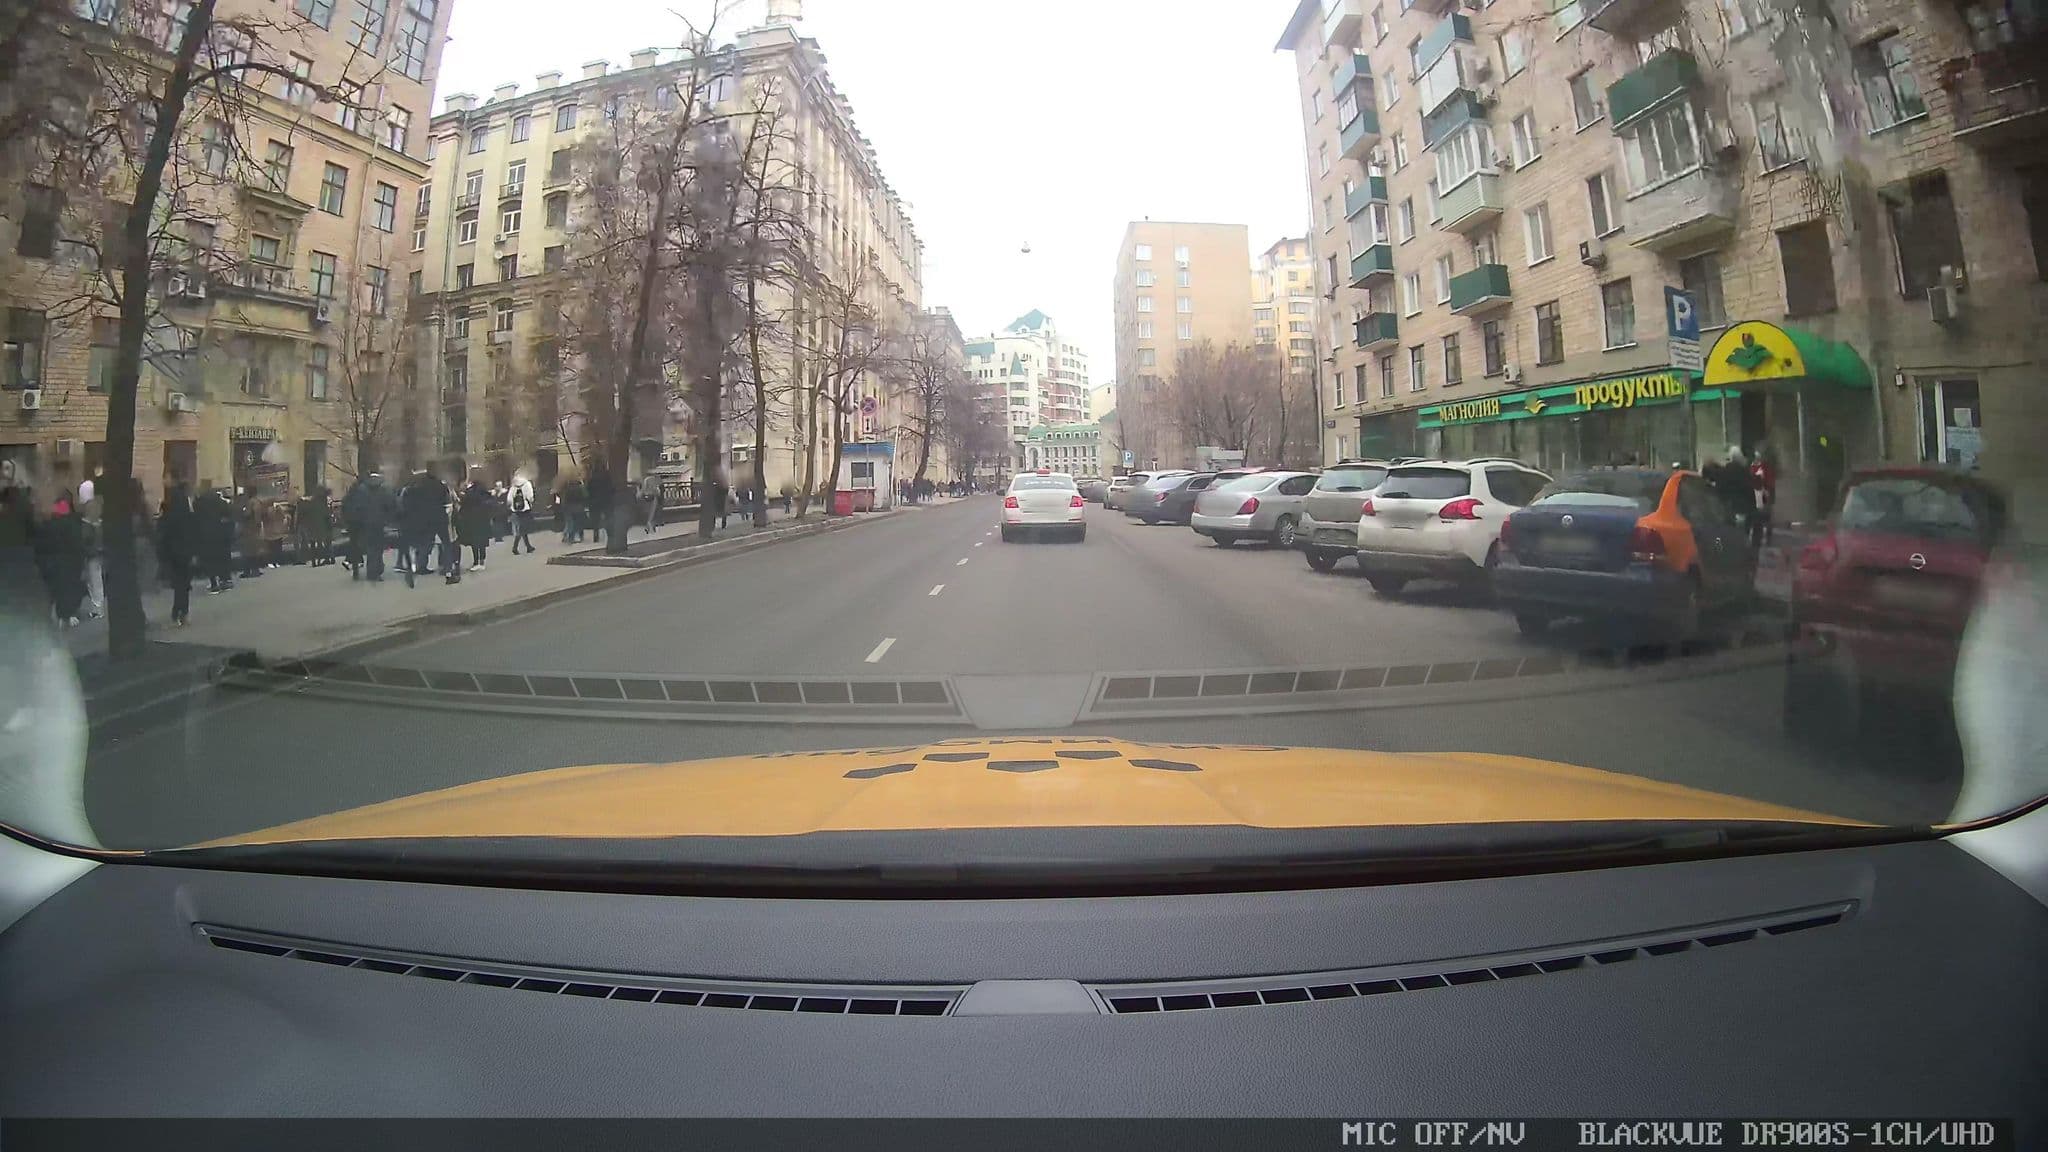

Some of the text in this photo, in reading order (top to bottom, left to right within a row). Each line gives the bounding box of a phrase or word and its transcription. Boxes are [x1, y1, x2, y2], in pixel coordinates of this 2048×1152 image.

[1672, 295, 1691, 331] P
[1440, 399, 1500, 421] МАГНОЛИЯ
[1125, 451, 1132, 461] P
